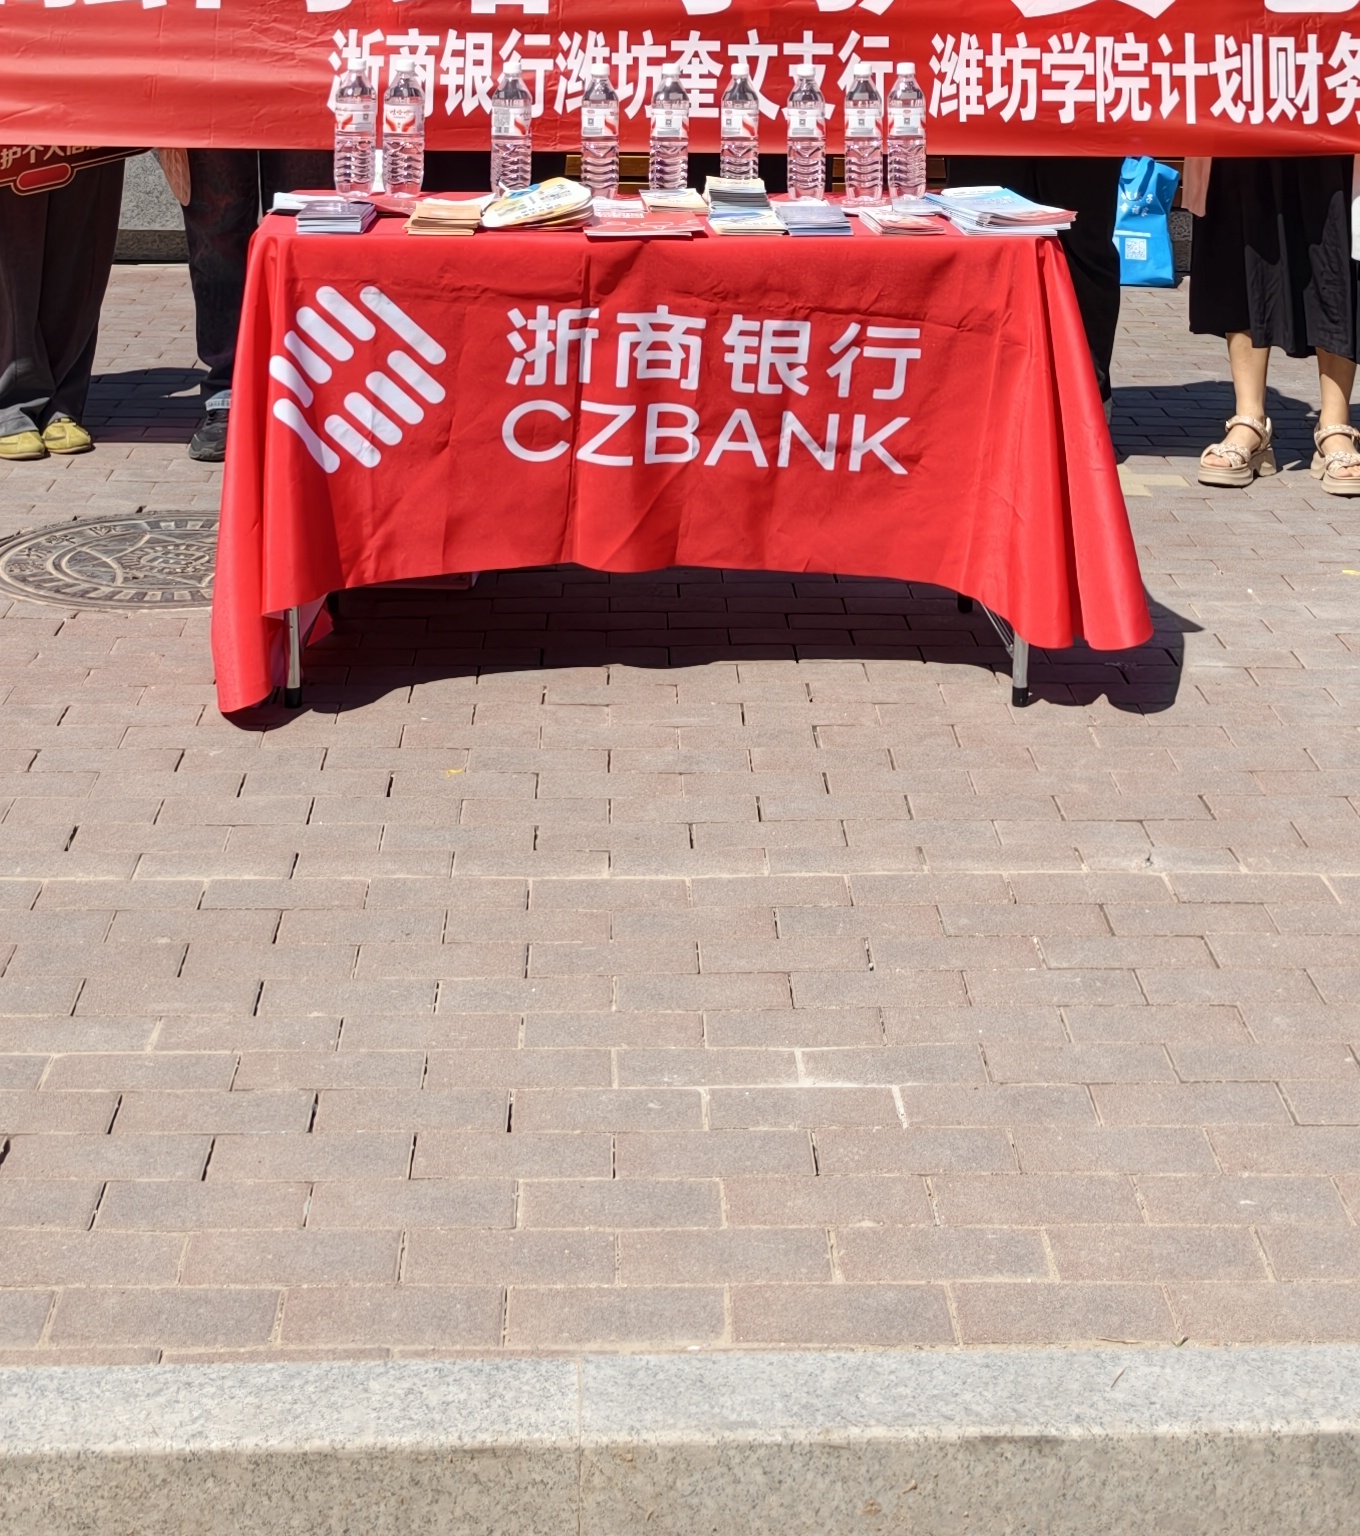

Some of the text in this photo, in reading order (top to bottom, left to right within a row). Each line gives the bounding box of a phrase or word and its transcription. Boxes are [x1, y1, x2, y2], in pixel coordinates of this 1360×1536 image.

[505, 303, 923, 401] 浙商银行
[501, 399, 911, 476] CZBANK
